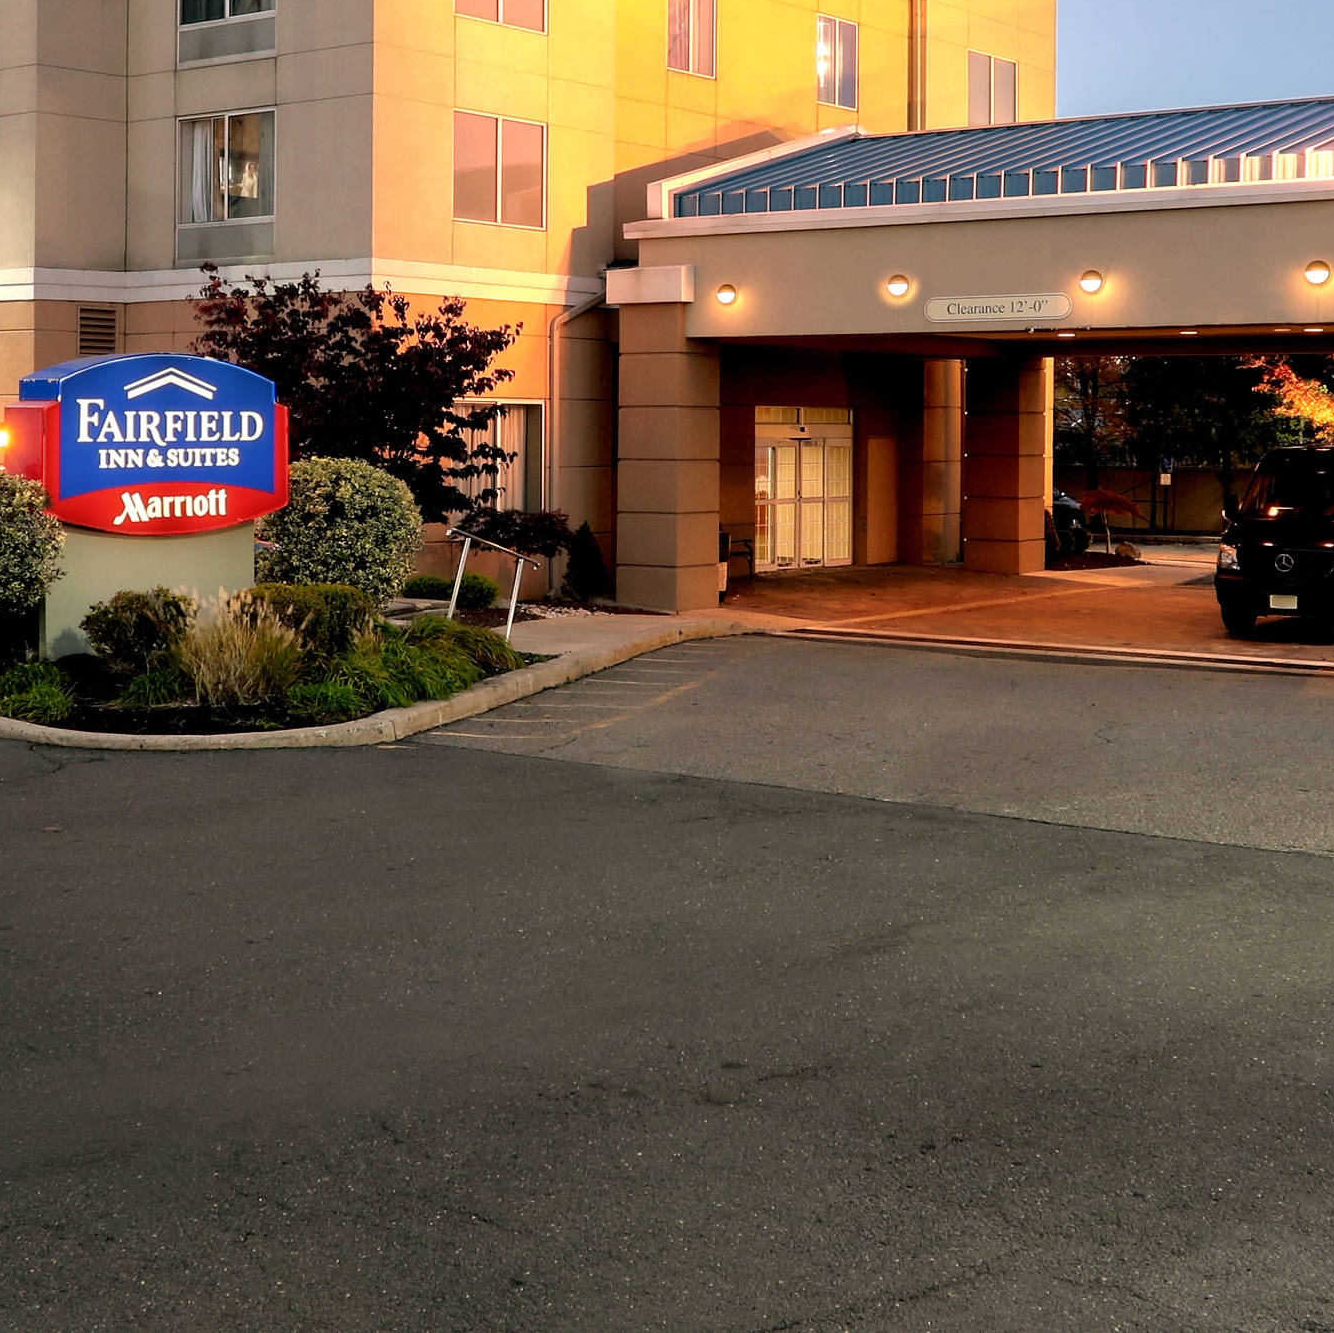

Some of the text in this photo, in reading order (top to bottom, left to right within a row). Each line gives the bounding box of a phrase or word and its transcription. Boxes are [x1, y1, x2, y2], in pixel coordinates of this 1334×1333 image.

[946, 302, 1005, 316] Clearance
[75, 397, 264, 447] FAIRFIELD
[98, 447, 240, 469] INN & SUITES
[113, 488, 228, 526] Marriott
